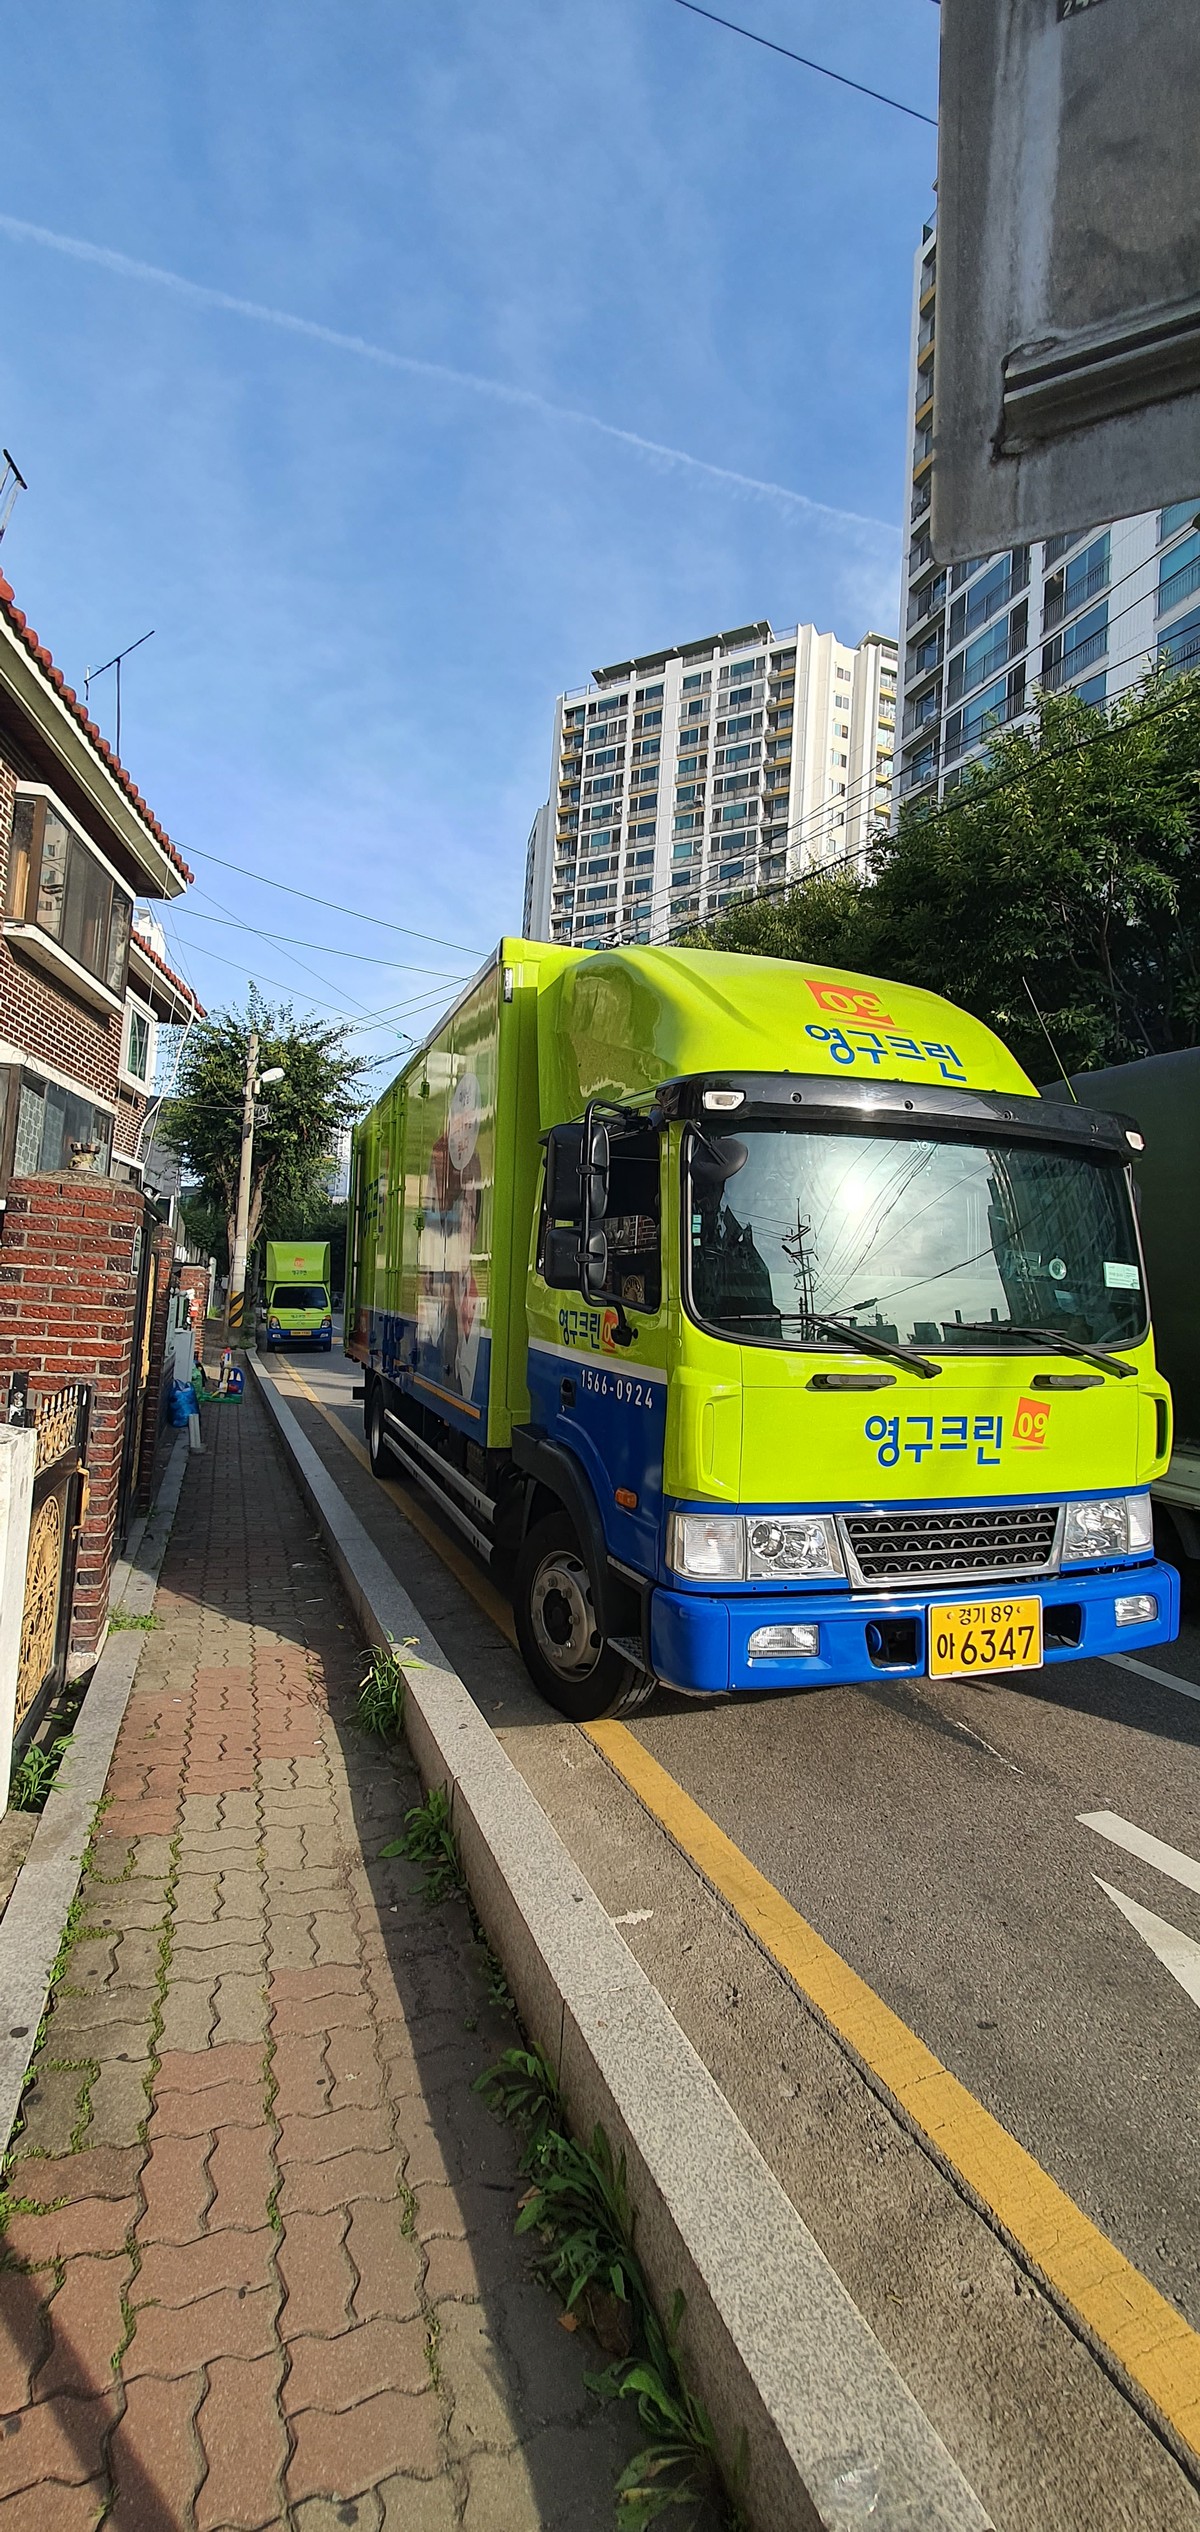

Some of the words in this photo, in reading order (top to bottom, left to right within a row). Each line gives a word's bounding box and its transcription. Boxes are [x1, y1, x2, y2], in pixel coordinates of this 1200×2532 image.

[820, 990, 889, 1017] 09
[804, 1024, 967, 1082] 영구크린
[559, 1309, 600, 1350] 영구크린
[582, 1369, 653, 1409] 1566-0924
[864, 1415, 1003, 1468] 영구크린
[1017, 1412, 1049, 1439] 09
[959, 1606, 985, 1625] 경기
[991, 1605, 1013, 1623] 89
